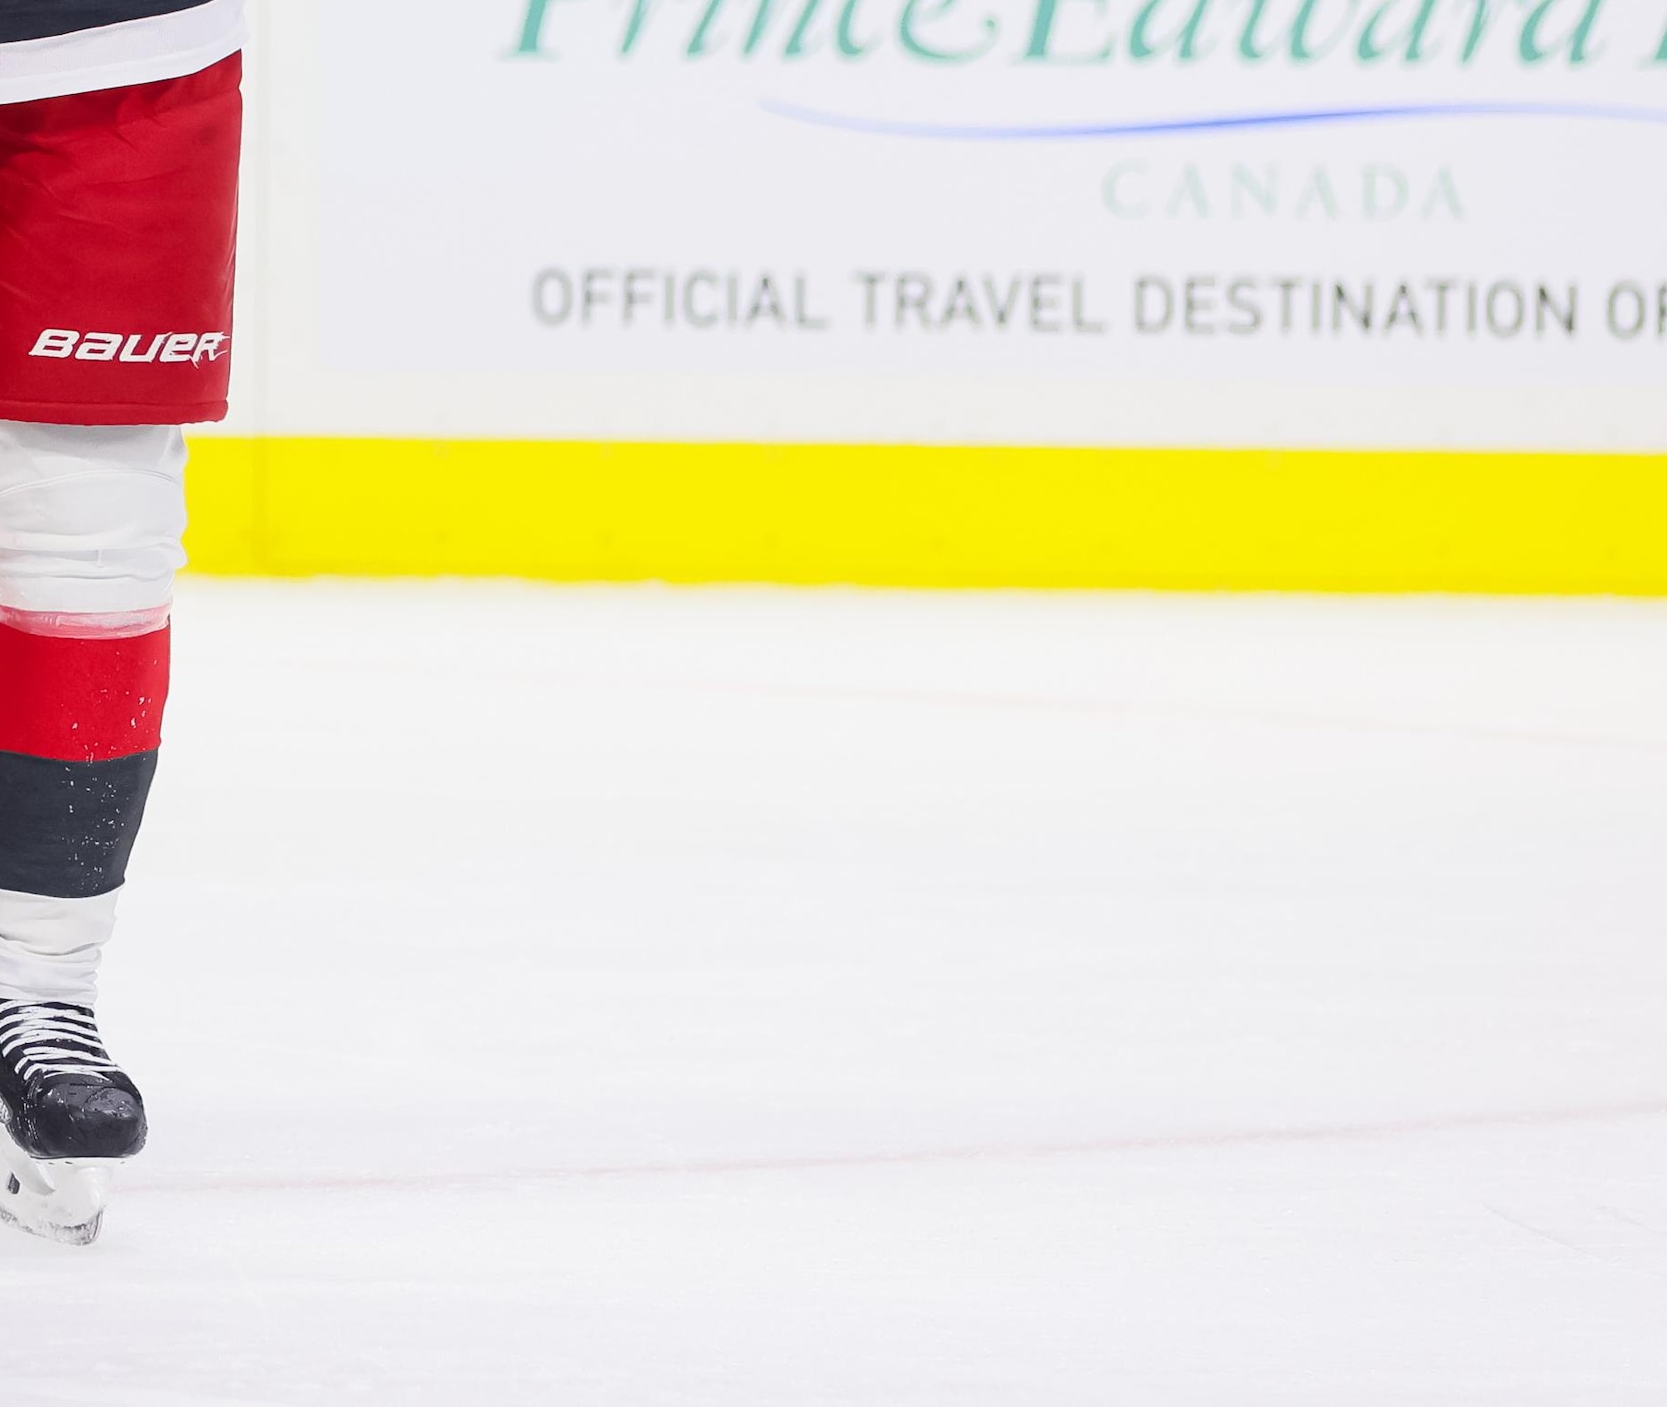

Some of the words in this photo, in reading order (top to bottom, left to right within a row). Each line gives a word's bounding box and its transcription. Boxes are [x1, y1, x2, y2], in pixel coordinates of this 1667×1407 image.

[1101, 161, 1465, 221] CANADA
[532, 269, 826, 331] OFFICIAL
[855, 271, 1104, 334] TRAVEL
[1134, 275, 1578, 339] DESTINATION
[1606, 278, 1667, 341] O
[28, 328, 230, 366] BAUER
